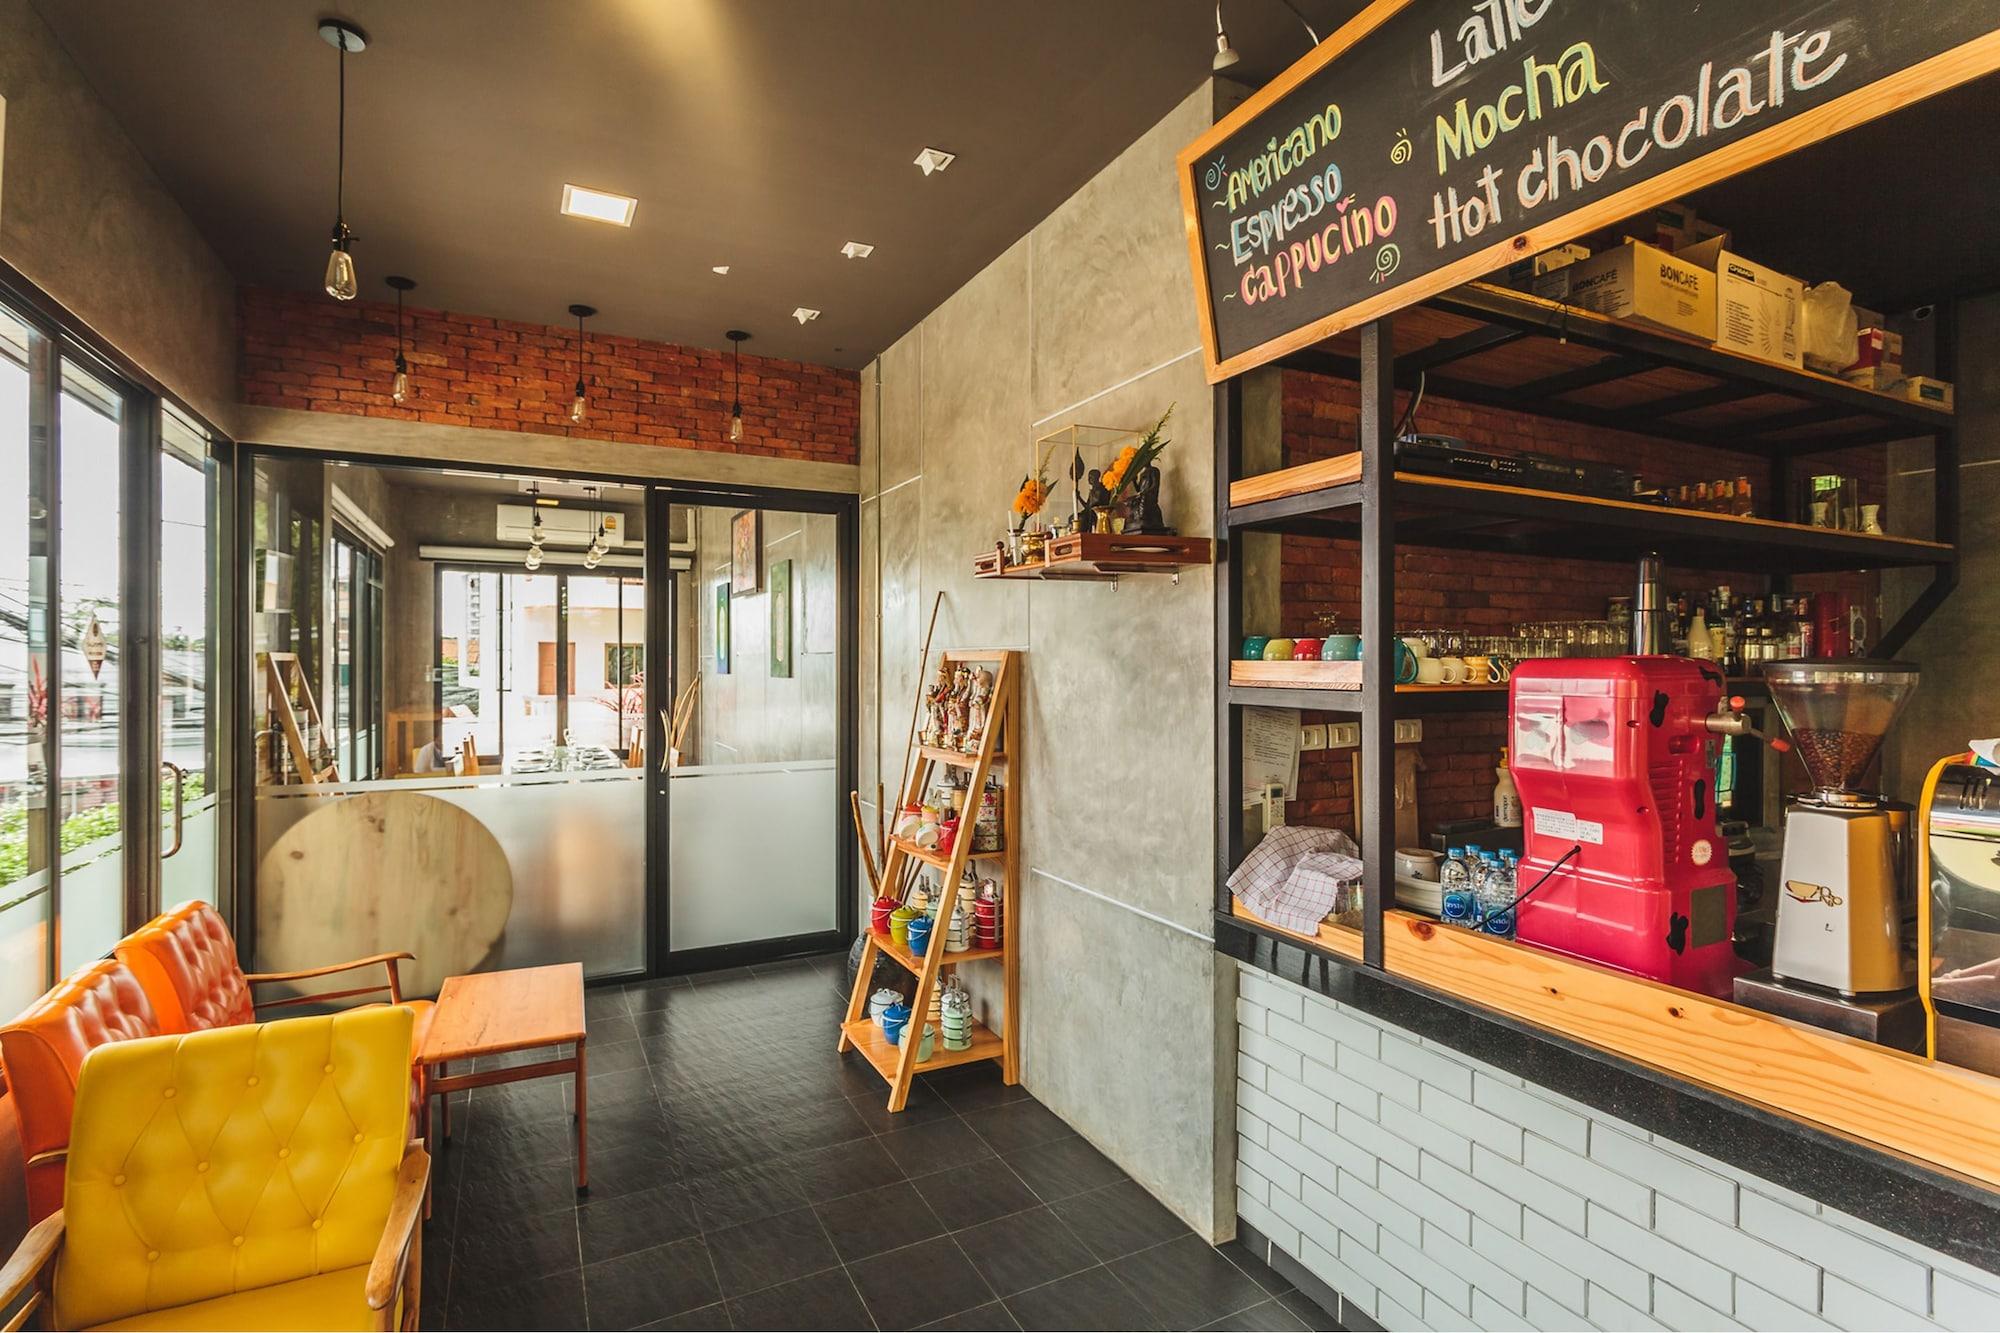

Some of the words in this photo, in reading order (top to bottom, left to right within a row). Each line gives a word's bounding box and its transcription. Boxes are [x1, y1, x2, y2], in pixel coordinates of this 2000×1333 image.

[1428, 164, 1503, 249] Hot
[1518, 30, 1848, 210] chocolate
[1436, 40, 1610, 176] Mocha
[1230, 163, 1342, 266] Espresso
